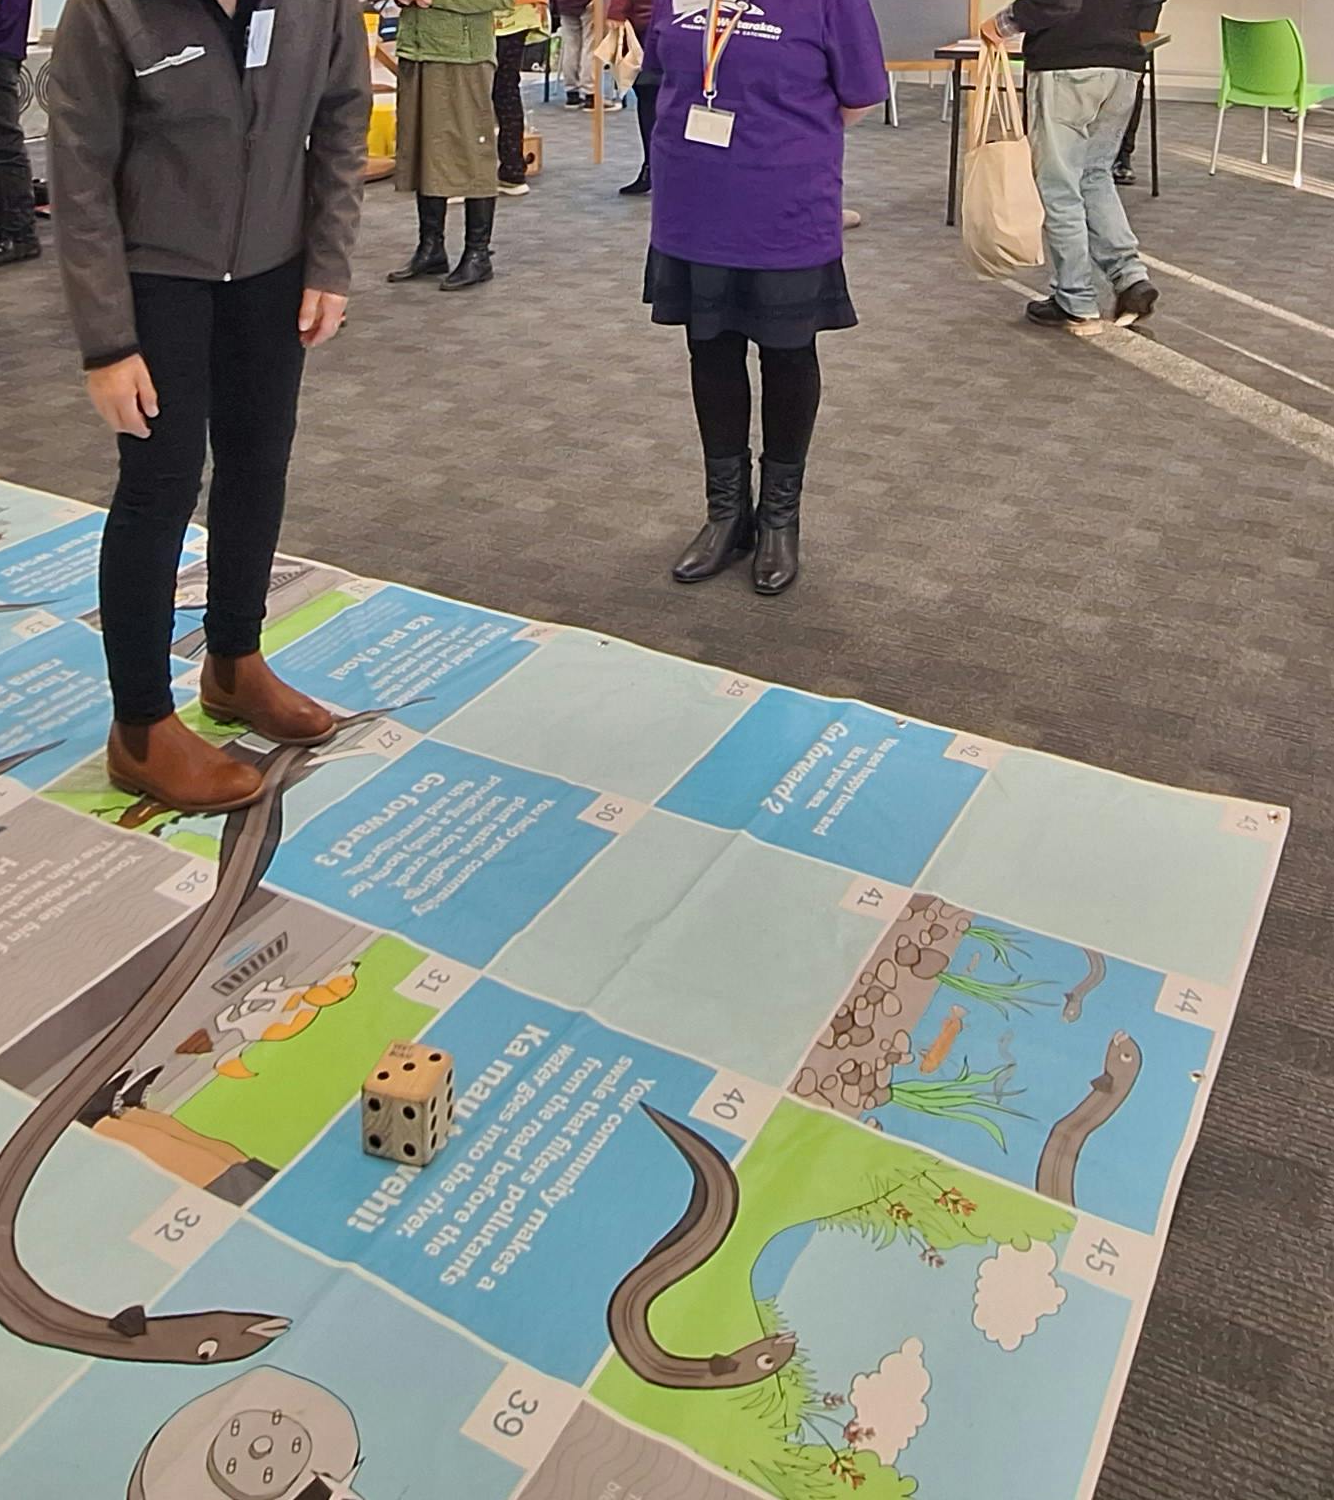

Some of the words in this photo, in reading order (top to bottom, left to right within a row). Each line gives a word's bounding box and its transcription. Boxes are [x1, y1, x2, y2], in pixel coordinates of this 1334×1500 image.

[25, 619, 47, 633] 13
[404, 615, 434, 629] Ka
[378, 629, 408, 647] pai
[8, 659, 61, 684] rawa
[327, 653, 372, 679] hoa!
[26, 670, 79, 693] Tino
[726, 679, 749, 696] 29
[378, 730, 402, 749] 27
[821, 722, 848, 741] Go
[878, 738, 899, 752] You
[960, 743, 980, 758] 42
[774, 742, 832, 801] forward
[839, 759, 856, 768] in
[866, 752, 884, 767] see
[411, 773, 444, 792] Go
[447, 780, 474, 796] fish
[825, 767, 845, 789] your
[842, 767, 875, 794] happy
[424, 796, 450, 815] and
[445, 775, 501, 817] providing
[530, 799, 555, 815] You
[761, 797, 783, 813] 2
[827, 794, 853, 815] tuna
[464, 796, 505, 824] beside
[493, 796, 526, 822] plant
[595, 802, 623, 822] 30
[331, 794, 418, 857] forward
[506, 815, 536, 837] help
[812, 816, 833, 835] and
[1237, 815, 1258, 831] 43
[80, 840, 115, 858] The
[402, 825, 441, 851] shady
[426, 834, 461, 857] local
[459, 823, 497, 853] native
[481, 836, 508, 859] your
[16, 859, 53, 880] into
[46, 858, 80, 879] rain
[104, 855, 142, 879] Your
[314, 854, 338, 865] 3
[368, 851, 409, 880] home
[176, 869, 209, 893] 26
[348, 880, 373, 897] for
[411, 859, 482, 915] community
[11, 879, 74, 918] rubbish
[38, 881, 101, 920] wheelie
[857, 888, 883, 906] 41
[6, 921, 39, 941] bin
[415, 968, 450, 993] 31
[1176, 989, 1202, 1014] 44
[504, 1024, 549, 1056] Ka
[533, 1044, 573, 1086] water
[561, 1057, 601, 1093] from
[592, 1056, 632, 1099] swale
[453, 1060, 512, 1117] mau
[499, 1081, 535, 1120] goes
[618, 1078, 655, 1111] Your
[538, 1094, 568, 1119] the
[713, 1088, 745, 1119] 40
[562, 1101, 599, 1135] that
[468, 1124, 507, 1159] into
[504, 1119, 542, 1160] road
[520, 1136, 570, 1183] filters
[540, 1114, 621, 1206] community
[440, 1162, 474, 1192] the
[454, 1161, 513, 1222] before
[155, 1207, 200, 1241] 32
[396, 1191, 444, 1237] river.
[424, 1224, 460, 1255] the
[440, 1185, 524, 1283] pollutants
[491, 1209, 546, 1273] makes
[1086, 1238, 1119, 1276] 45
[476, 1276, 495, 1289] a
[494, 1390, 538, 1436] 39
